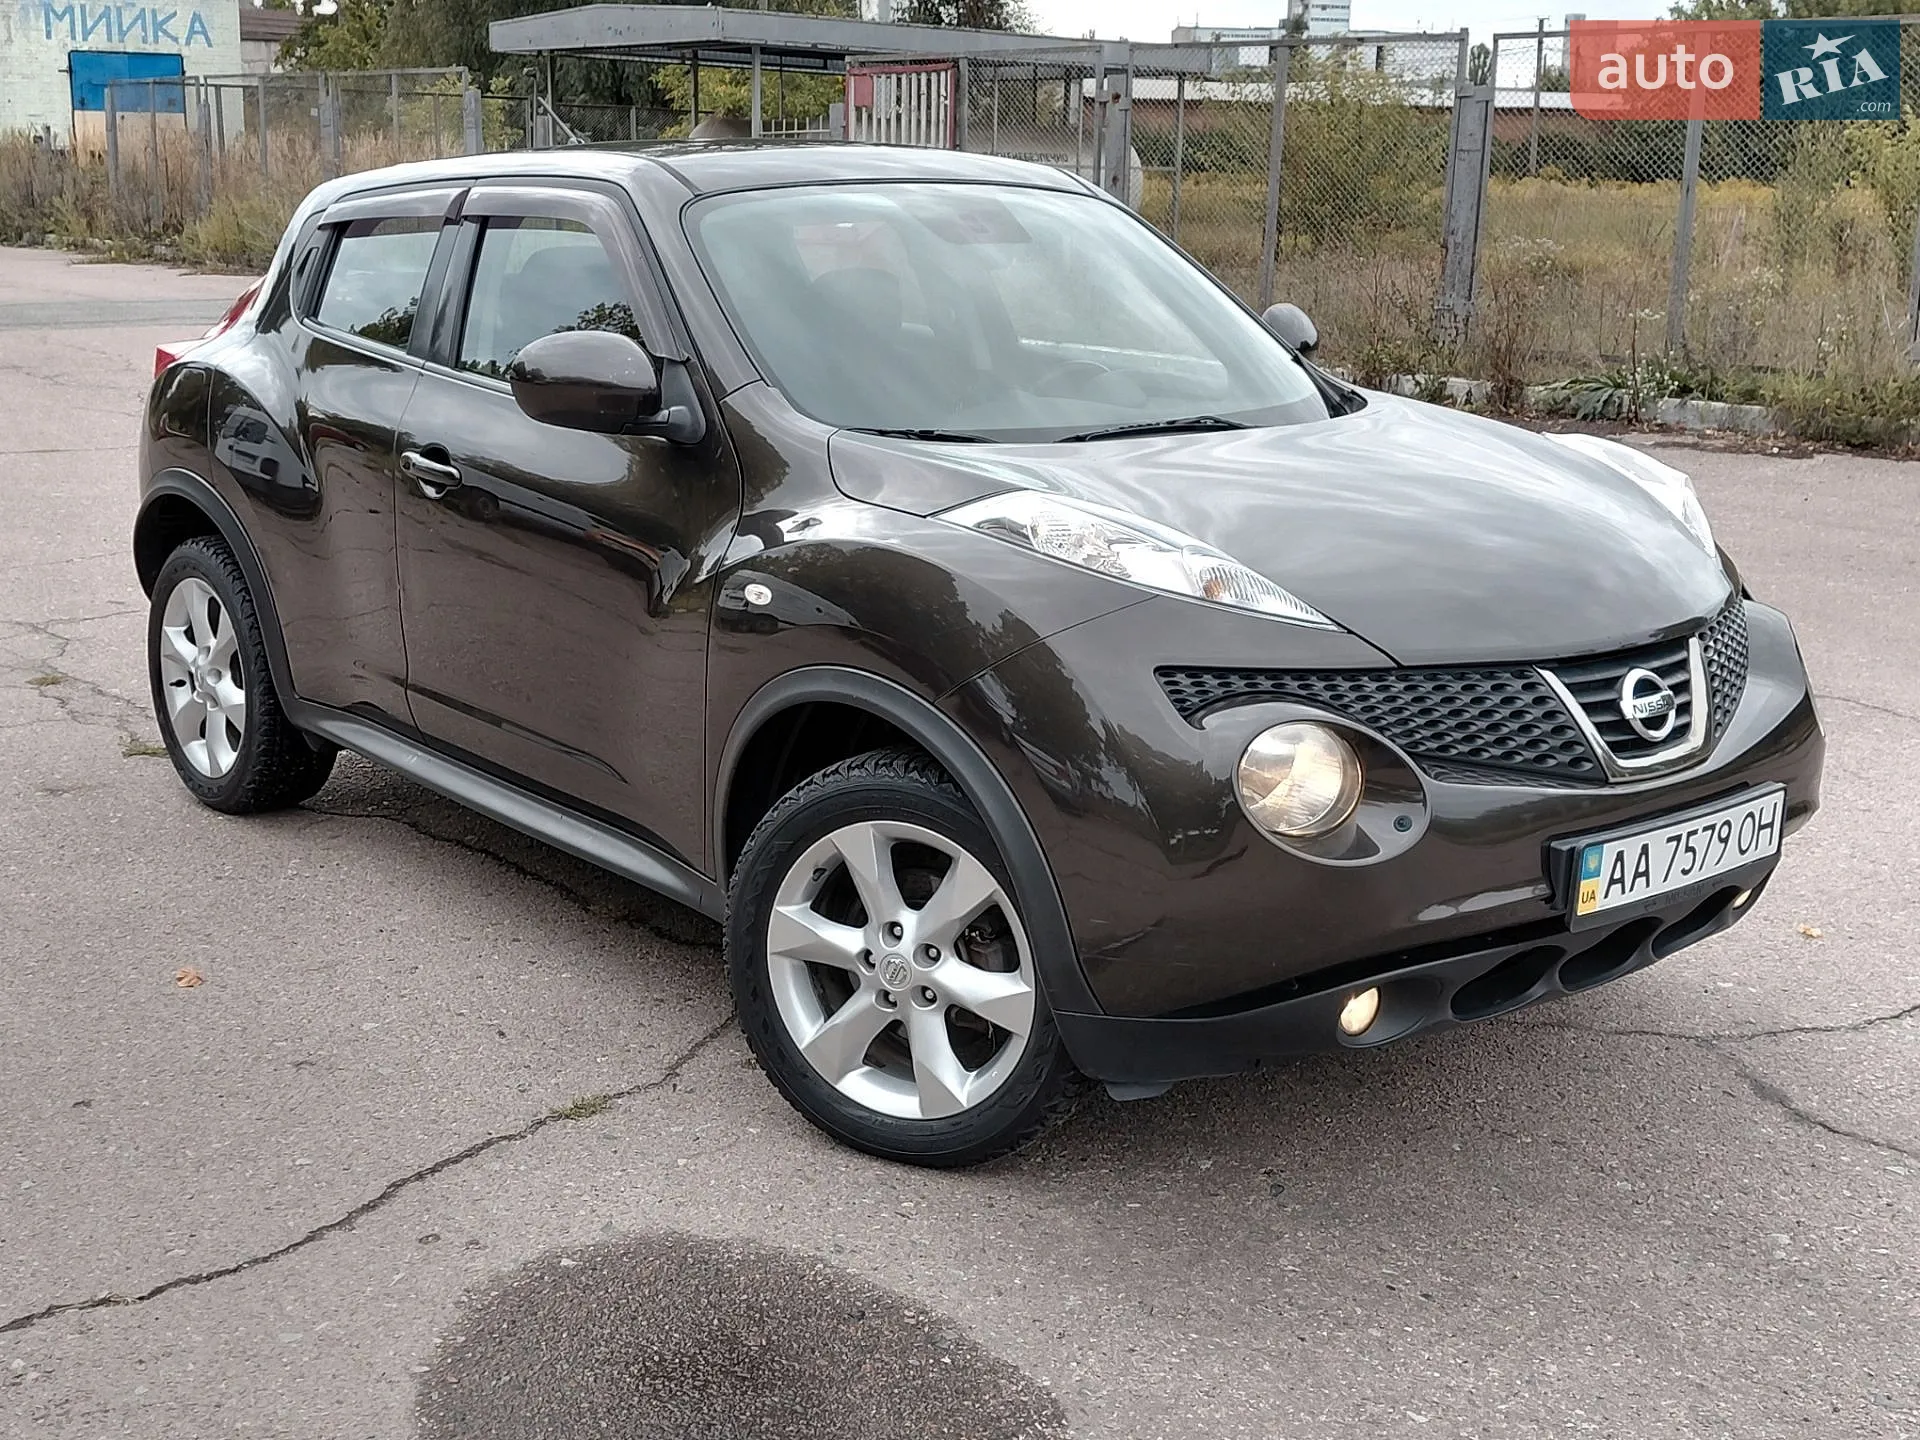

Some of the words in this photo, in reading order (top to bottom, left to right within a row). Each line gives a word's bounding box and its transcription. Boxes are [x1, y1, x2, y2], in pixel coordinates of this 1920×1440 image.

[1603, 842, 1651, 900] AA
[1662, 819, 1733, 884] 7579
[1737, 801, 1778, 856] OH
[1581, 889, 1596, 904] UA
